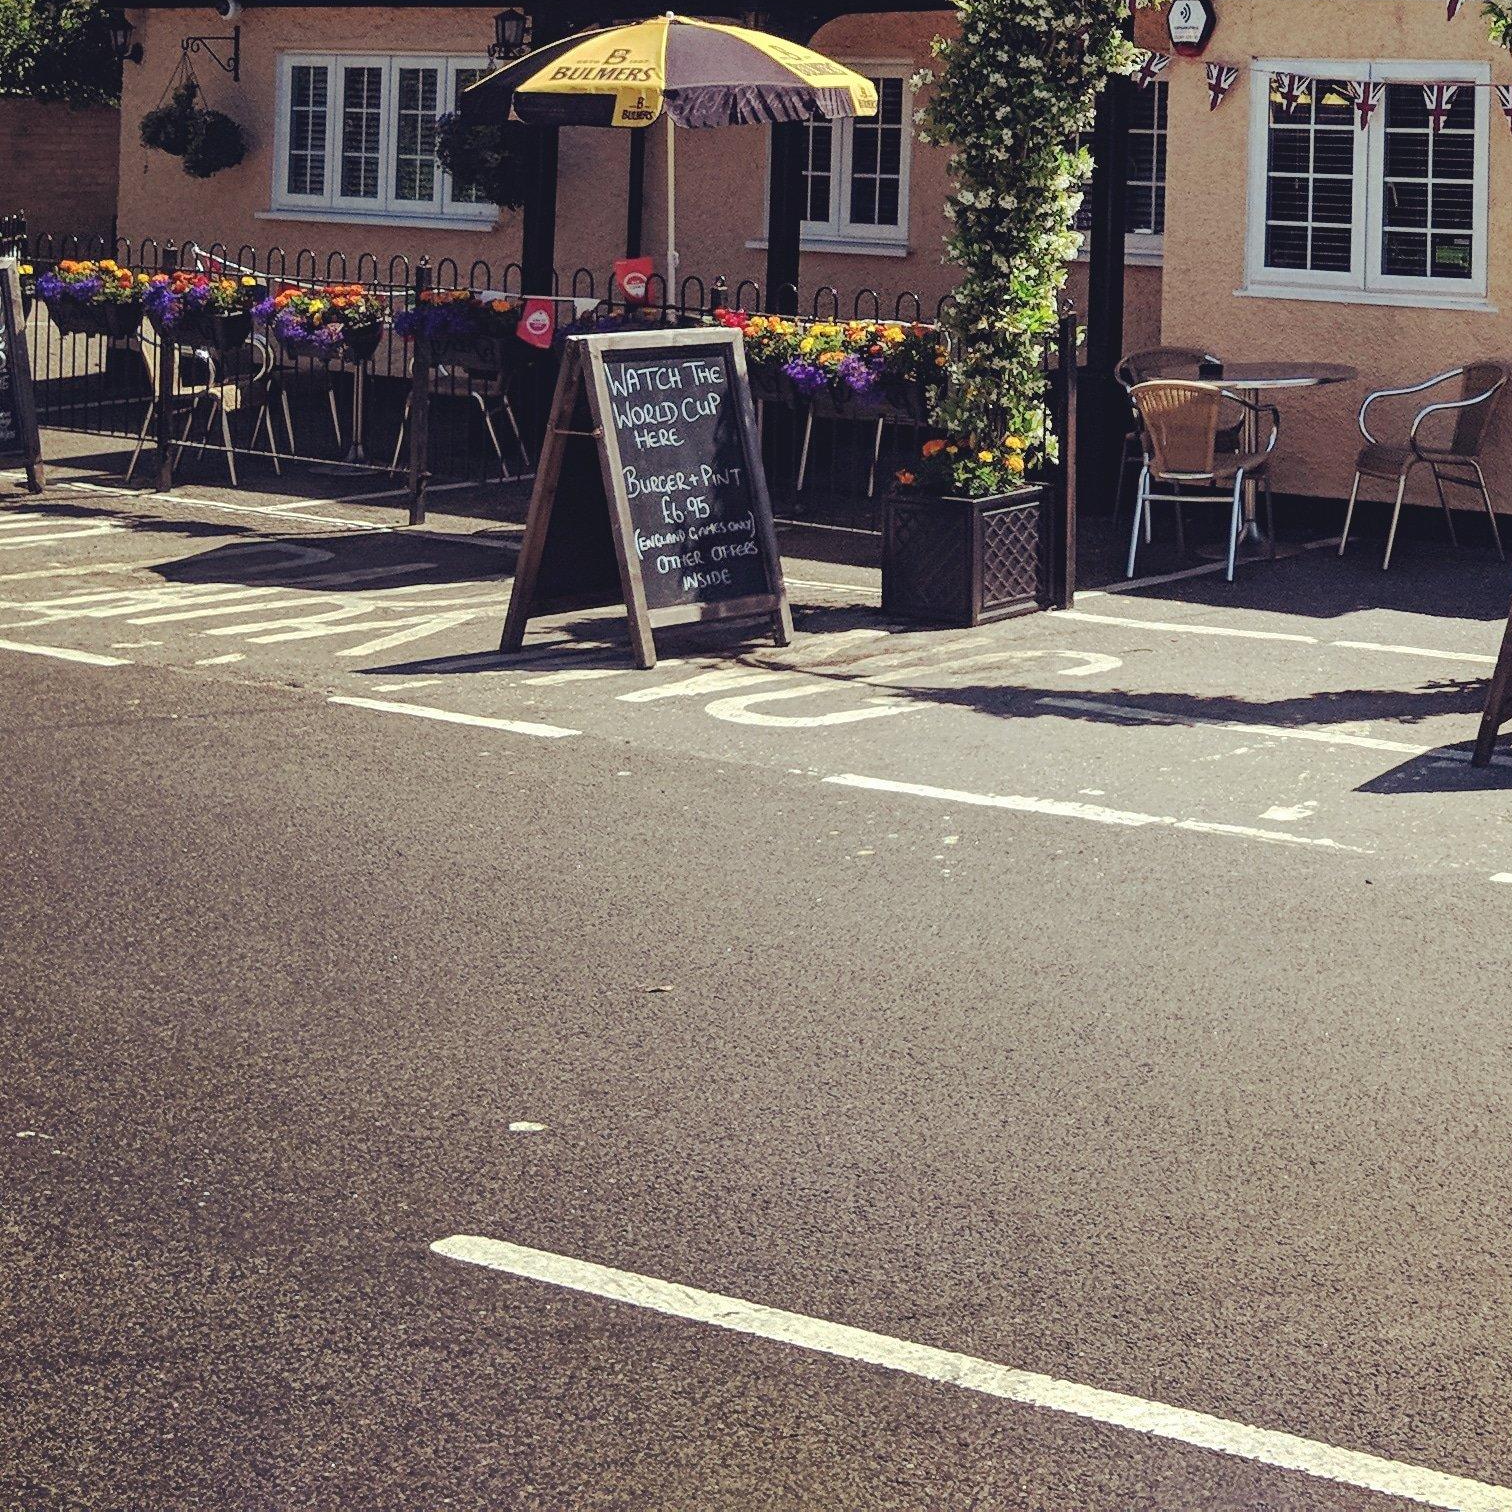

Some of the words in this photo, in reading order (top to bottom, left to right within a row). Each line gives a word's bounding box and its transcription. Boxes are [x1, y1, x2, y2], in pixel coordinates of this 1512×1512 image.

[548, 66, 657, 82] BULMERS
[621, 109, 655, 121] BULMERS
[604, 362, 683, 397] WATCH
[612, 400, 679, 430] WORLD
[681, 392, 721, 423] CUP
[633, 428, 685, 450] HERE
[682, 569, 732, 591] INSIDE
